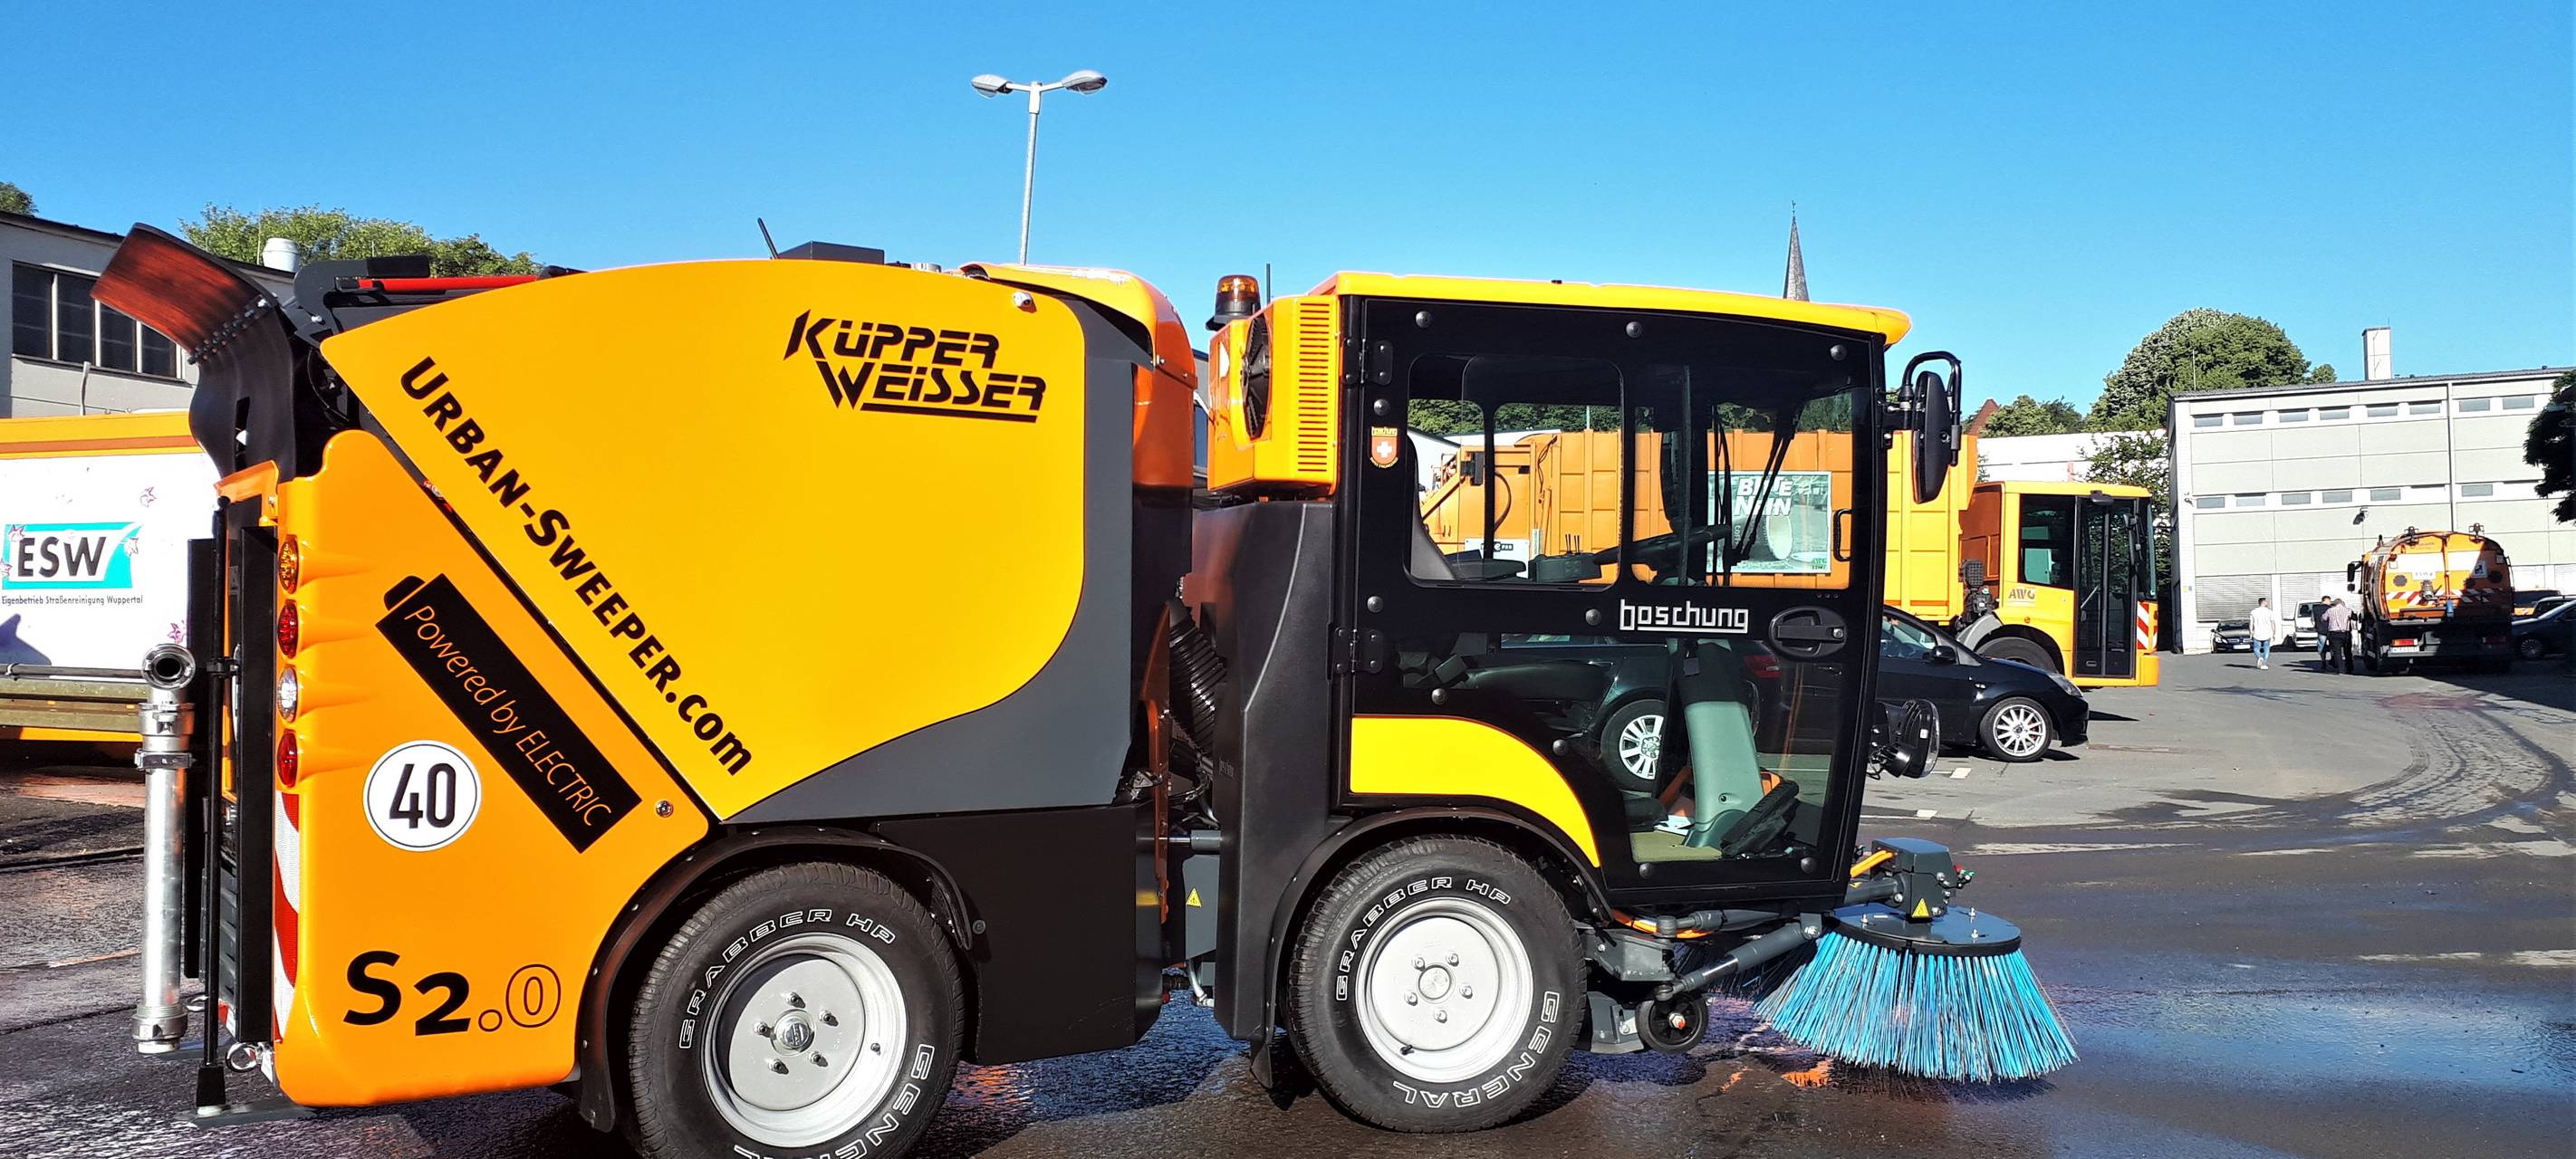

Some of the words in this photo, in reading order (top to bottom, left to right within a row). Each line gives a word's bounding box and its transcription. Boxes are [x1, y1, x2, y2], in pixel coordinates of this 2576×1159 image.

[783, 309, 1000, 369] KÜPPER
[18, 536, 107, 578] ESW
[2, 596, 43, 607] Eigenbetrieb
[45, 596, 105, 607] Straßenreinigung
[107, 595, 143, 606] Wuppertal
[1620, 599, 1749, 634] boschung
[404, 605, 506, 705] Powered
[490, 700, 526, 733] by
[515, 730, 611, 826] ELECTRIC
[389, 762, 457, 829] 40
[1336, 876, 1452, 1001] GRABBER
[1466, 879, 1511, 905] HP
[679, 909, 831, 1049] GRABBER
[846, 914, 896, 944] HP
[1393, 991, 1560, 1107] GENERAL
